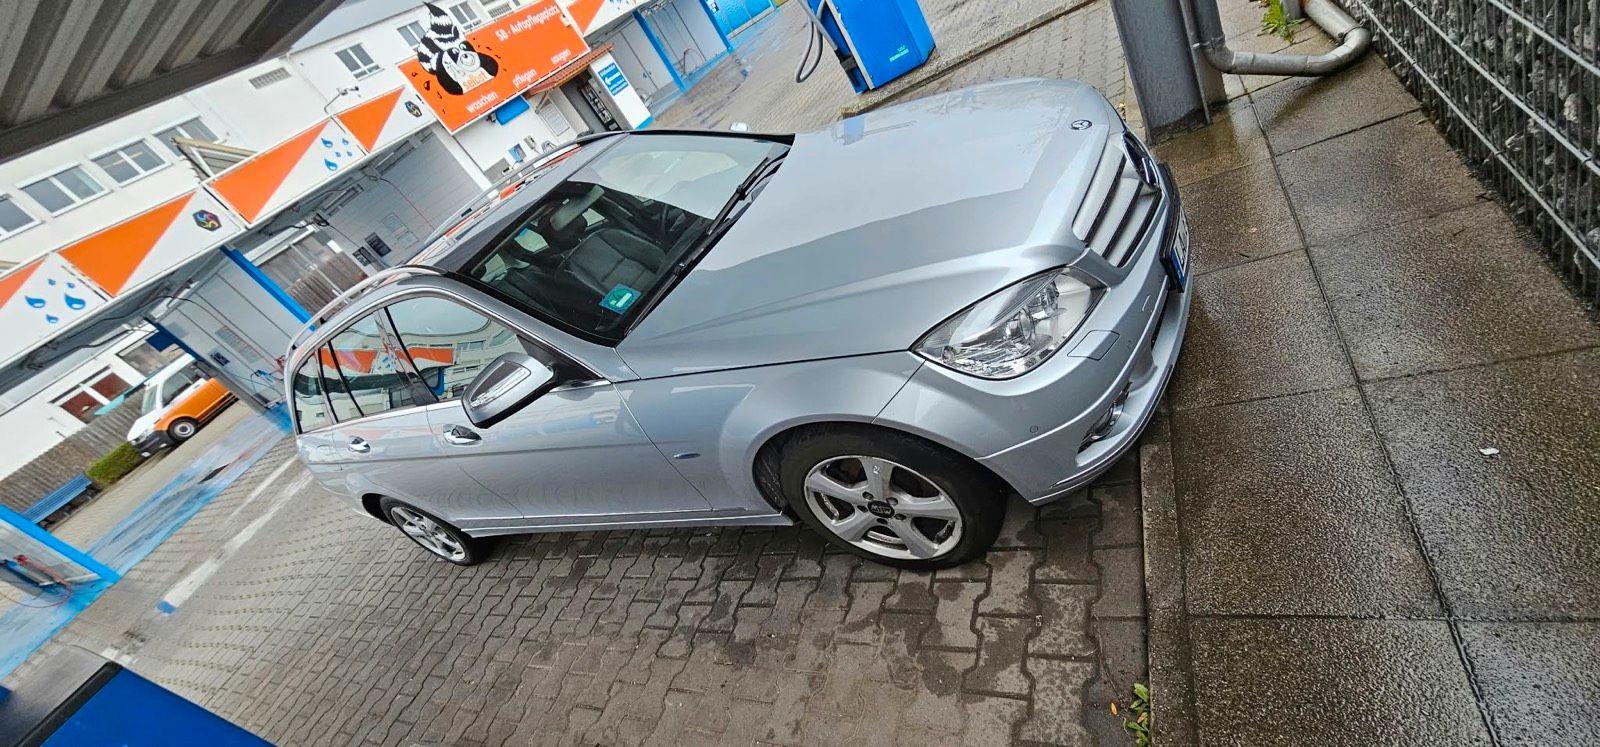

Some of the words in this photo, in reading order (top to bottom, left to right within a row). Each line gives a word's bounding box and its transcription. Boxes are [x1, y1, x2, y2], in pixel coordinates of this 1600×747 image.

[495, 28, 508, 41] SB
[550, 49, 571, 64] saugen
[466, 91, 498, 113] waschen
